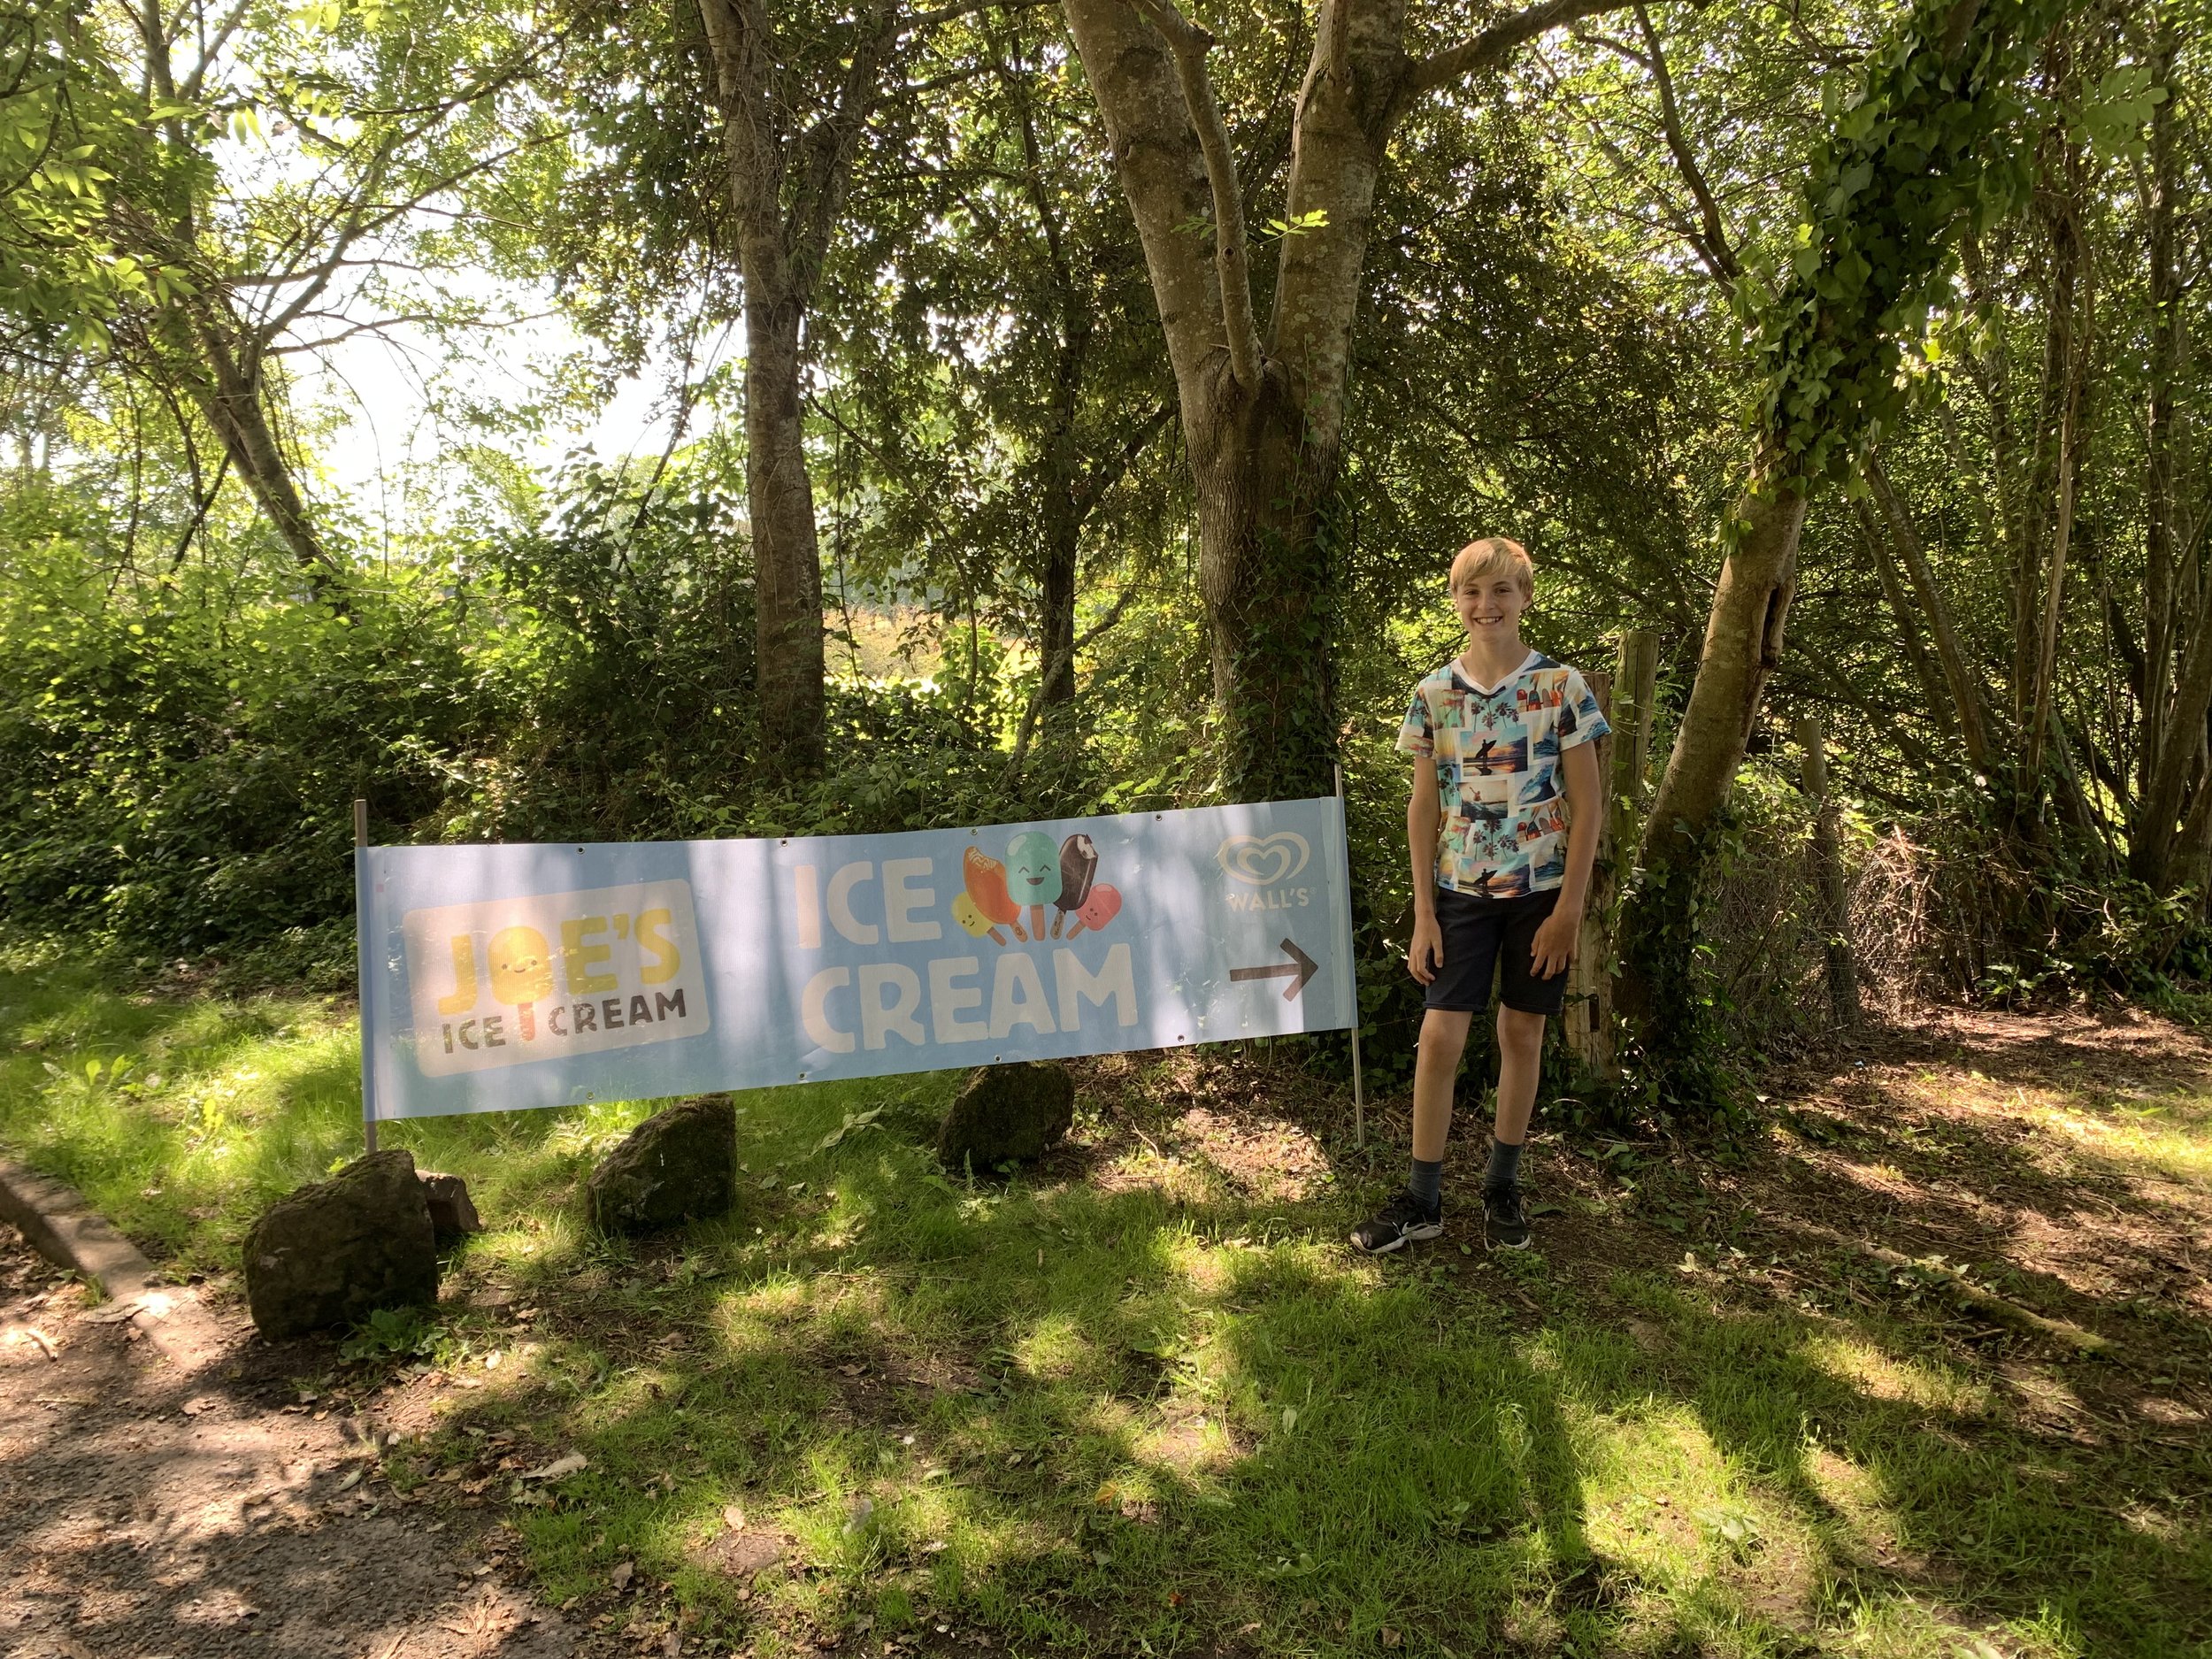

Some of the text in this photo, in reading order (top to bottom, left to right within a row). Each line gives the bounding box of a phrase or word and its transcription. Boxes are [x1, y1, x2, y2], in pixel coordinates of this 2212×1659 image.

[794, 856, 942, 949] ICE
[1225, 887, 1310, 913] WALL'S
[437, 908, 681, 1016] JOE'S
[801, 943, 1139, 1053] CREAM
[442, 988, 687, 1054] ICE CREAM
